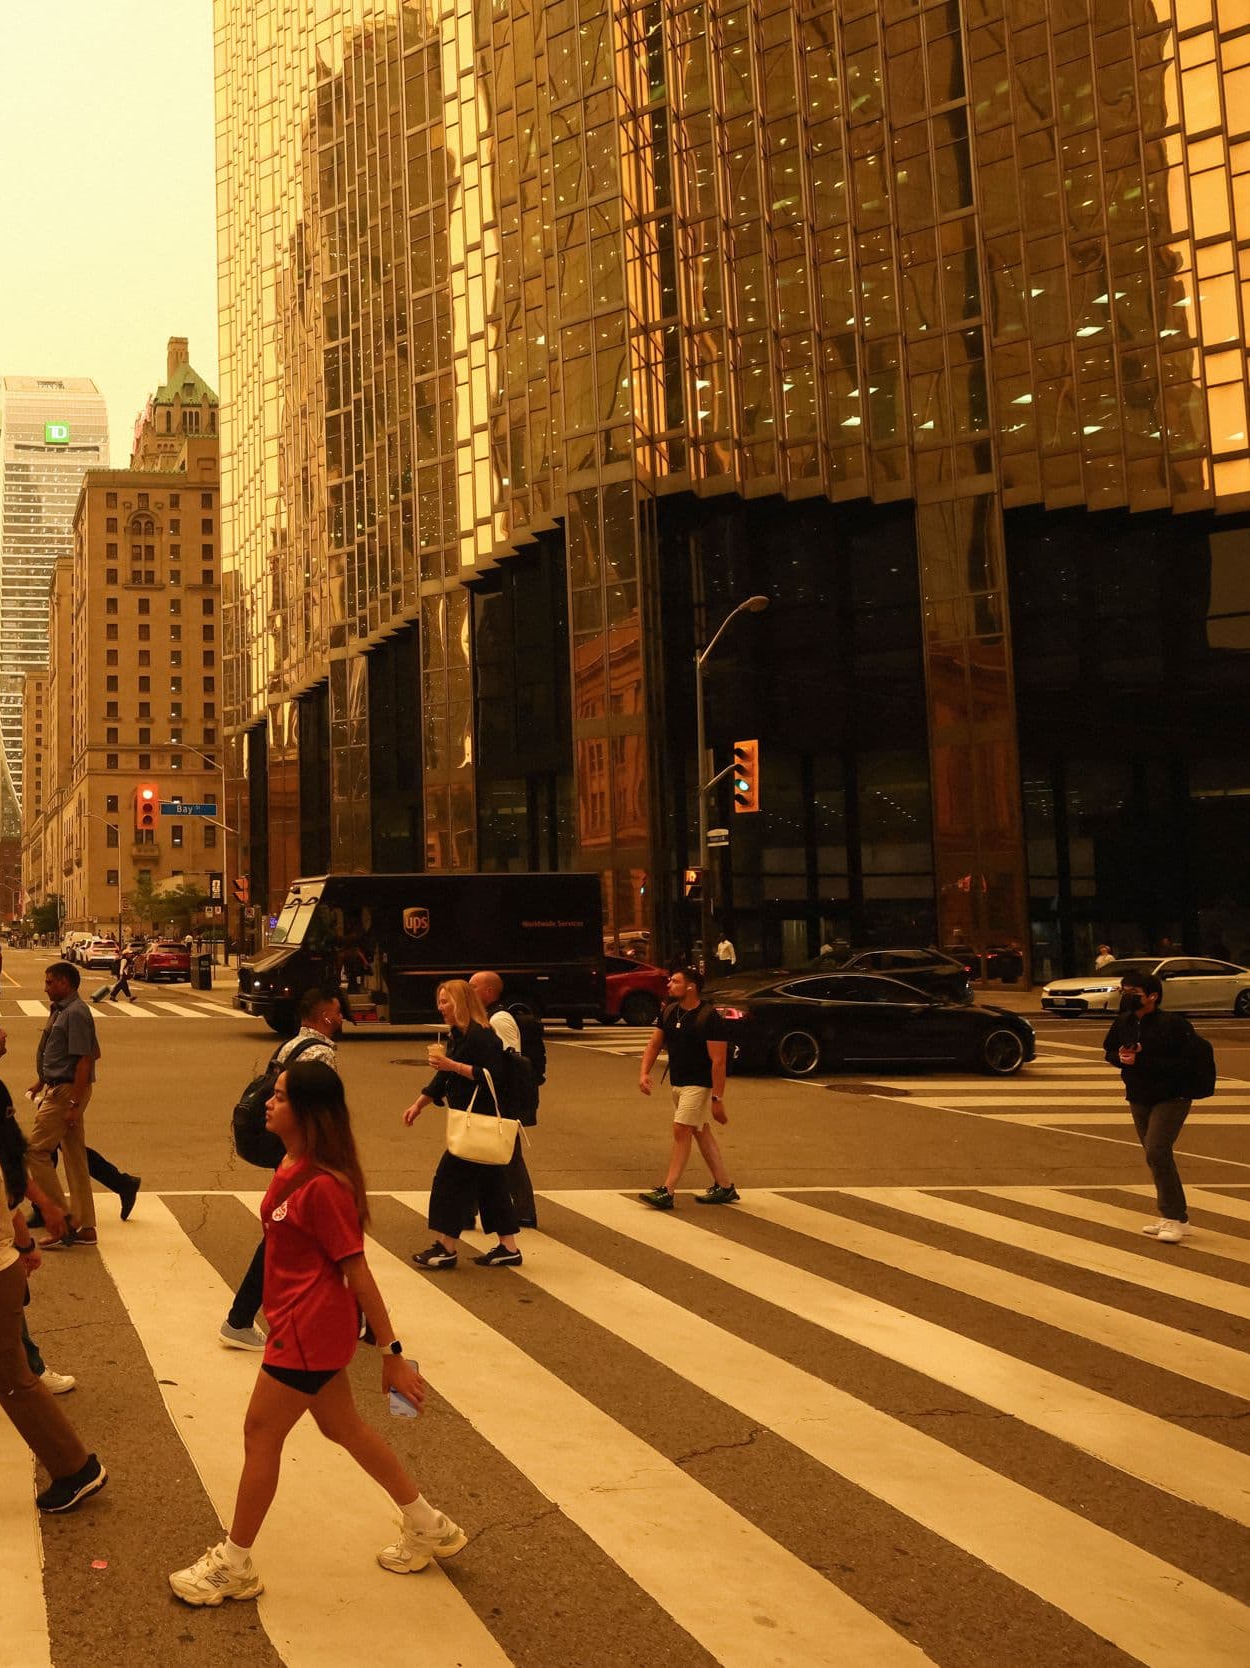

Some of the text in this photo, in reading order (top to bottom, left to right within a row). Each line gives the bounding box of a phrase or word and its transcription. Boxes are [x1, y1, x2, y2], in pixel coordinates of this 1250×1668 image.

[47, 425, 68, 439] TD
[176, 805, 193, 815] Bay
[405, 914, 428, 933] ups
[204, 1571, 230, 1588] N
